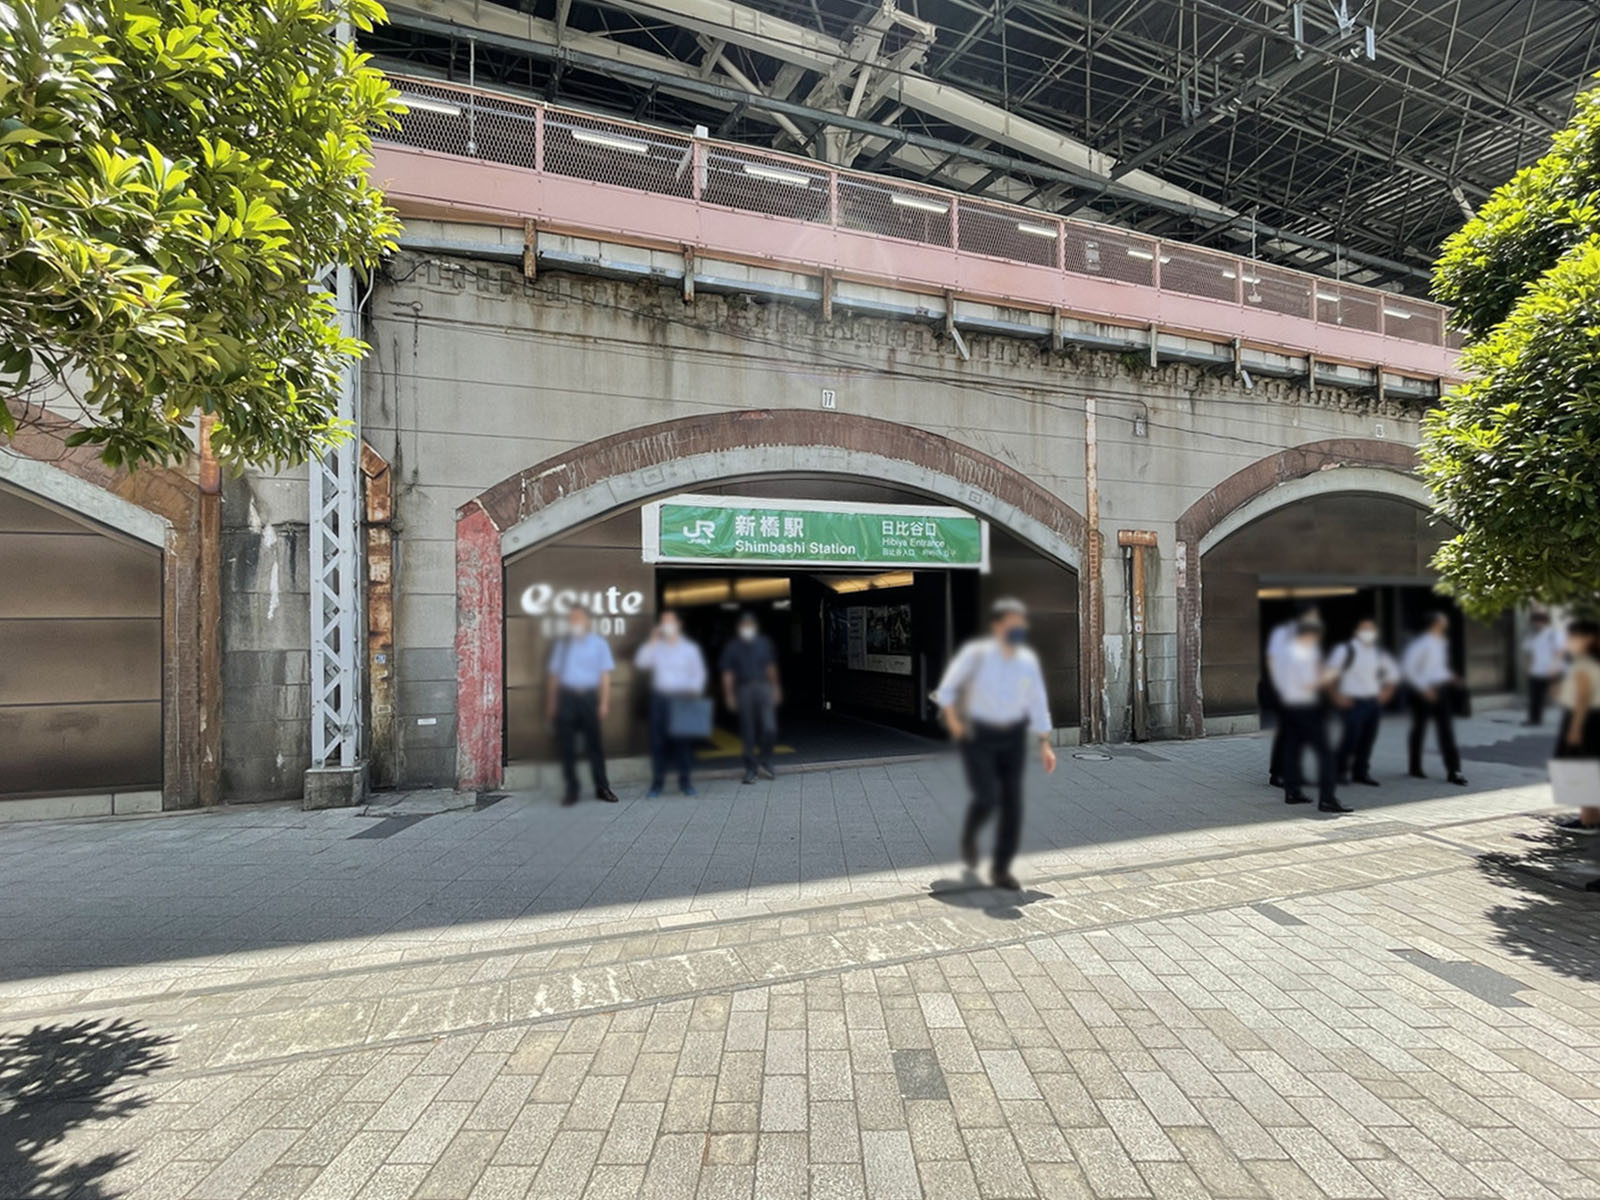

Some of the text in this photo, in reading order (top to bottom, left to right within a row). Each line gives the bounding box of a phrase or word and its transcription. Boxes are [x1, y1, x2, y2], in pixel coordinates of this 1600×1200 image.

[823, 391, 834, 407] 17
[683, 520, 715, 538] JR
[736, 515, 804, 538] 新橋駅
[882, 521, 936, 536] 日比谷口
[735, 539, 857, 555] Shimbashi Station
[882, 537, 945, 548] Hibiya Entrance
